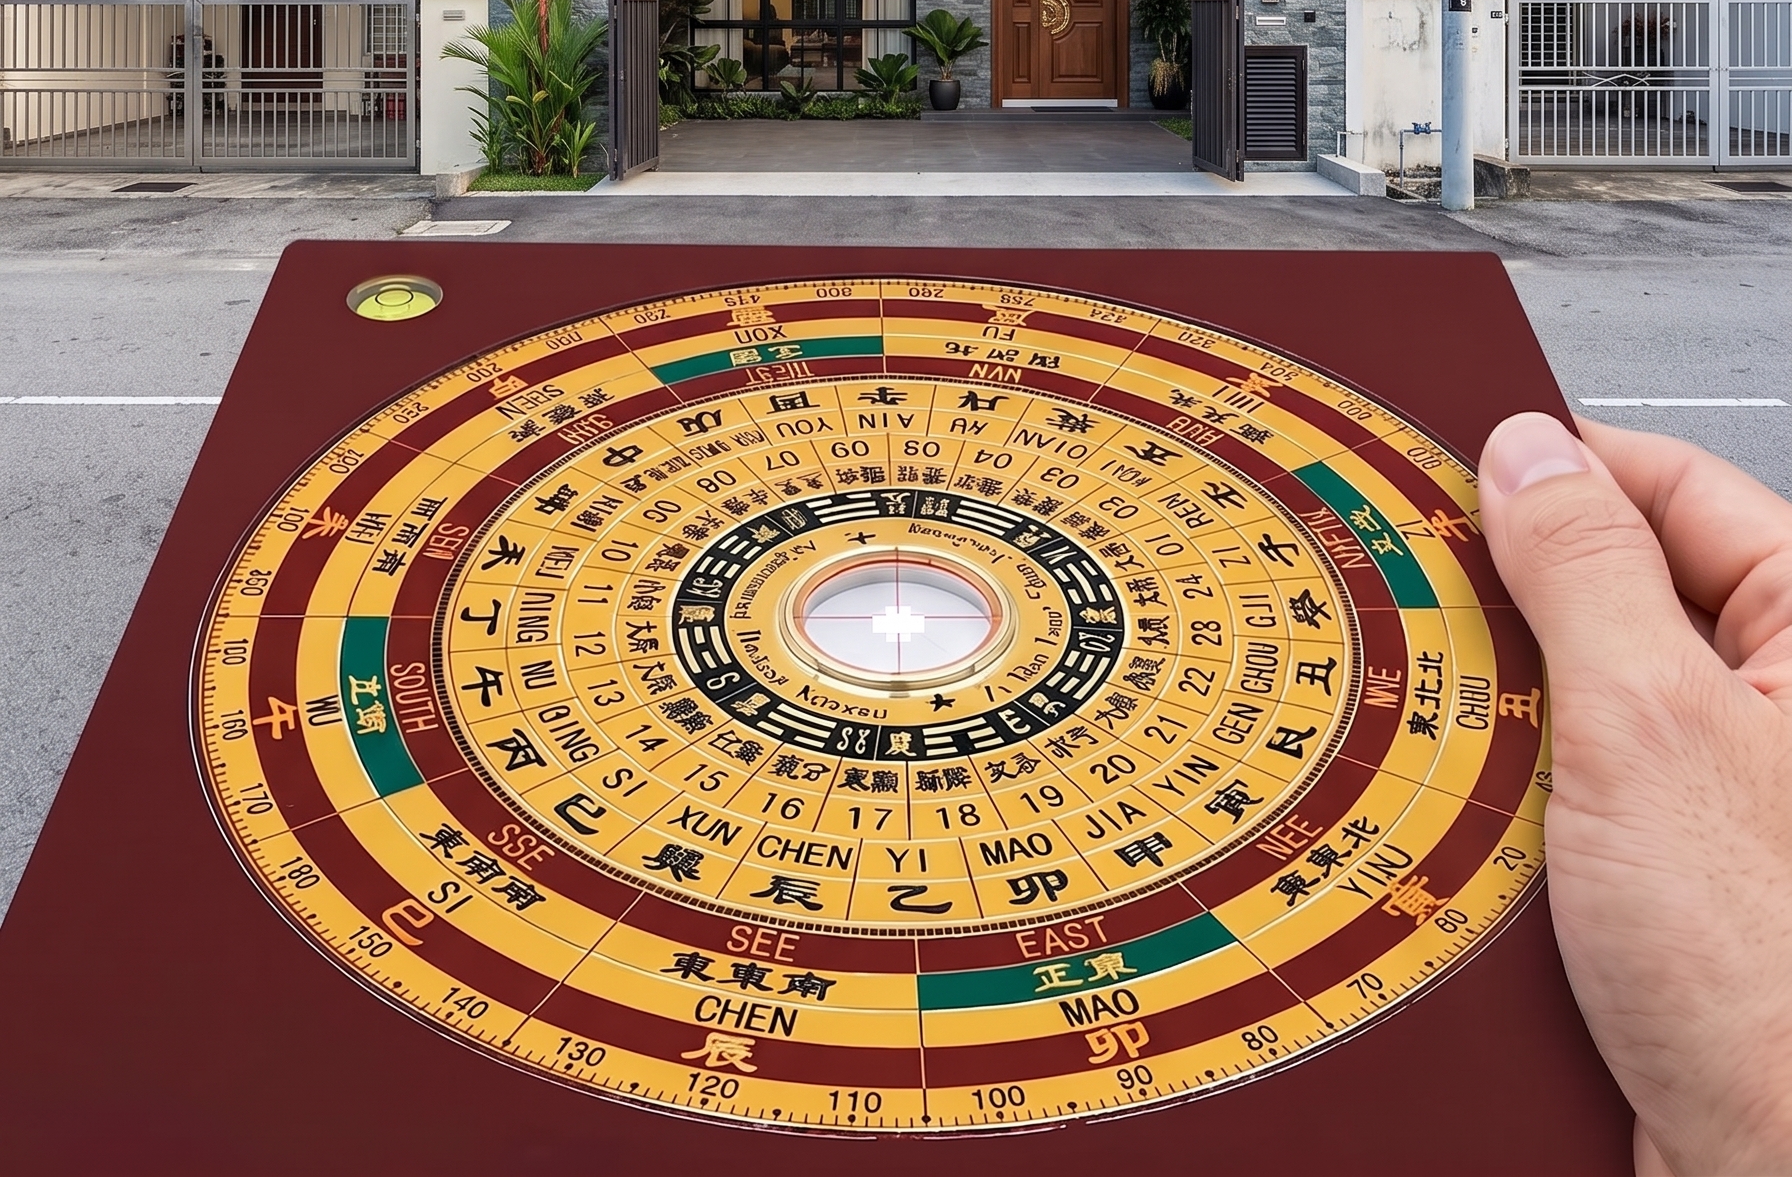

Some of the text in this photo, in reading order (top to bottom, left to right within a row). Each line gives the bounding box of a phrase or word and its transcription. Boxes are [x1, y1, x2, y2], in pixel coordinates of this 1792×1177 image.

[775, 417, 834, 438] YOU
[601, 539, 639, 562] 10
[1211, 546, 1252, 569] ZI
[577, 584, 614, 604] 11
[1175, 573, 1214, 600] 24
[460, 598, 502, 636] 丁
[573, 631, 607, 658] 12
[1190, 620, 1223, 647] 28
[460, 665, 504, 708] 午
[1177, 667, 1216, 697] 22
[1295, 656, 1338, 697] 丑
[389, 662, 439, 734] SOUTH
[587, 679, 625, 707] 13
[220, 709, 249, 741] 160
[252, 696, 299, 740] 午
[305, 694, 343, 727] WU
[1212, 702, 1265, 745] GEN
[625, 724, 669, 753] 14
[1143, 714, 1188, 745] 21
[485, 728, 548, 772] 丙
[602, 768, 648, 798] SI
[683, 763, 730, 792] 15
[1089, 754, 1136, 785] 20
[1151, 754, 1220, 797] YIN
[239, 782, 274, 815] 170
[761, 792, 805, 820] 16
[1019, 785, 1064, 814] 19
[666, 805, 743, 847] XUN
[848, 806, 893, 831] 17
[935, 803, 981, 830] 18
[1085, 801, 1147, 840] JIA
[487, 823, 555, 871] SSE
[756, 834, 854, 871] CHEN
[979, 832, 1053, 867] MAO
[1255, 814, 1324, 861] NEE
[279, 856, 321, 890] 180
[885, 847, 927, 873] YI
[1492, 846, 1527, 872] 20
[427, 881, 474, 914] SI
[887, 885, 953, 915] 乙
[1005, 868, 1069, 905] 卯
[348, 925, 393, 958] 150
[726, 925, 800, 963] SEE
[1015, 915, 1107, 959] EAST
[1346, 972, 1384, 1000] 70
[441, 987, 489, 1019] 140
[694, 994, 799, 1037] CHEN
[1058, 988, 1140, 1028] MAO
[556, 1036, 606, 1067] 130
[1241, 1025, 1279, 1051] 80
[688, 1071, 740, 1099] 120
[1116, 1064, 1153, 1090] 90
[828, 1090, 882, 1114] 110
[971, 1085, 1026, 1111] 100
